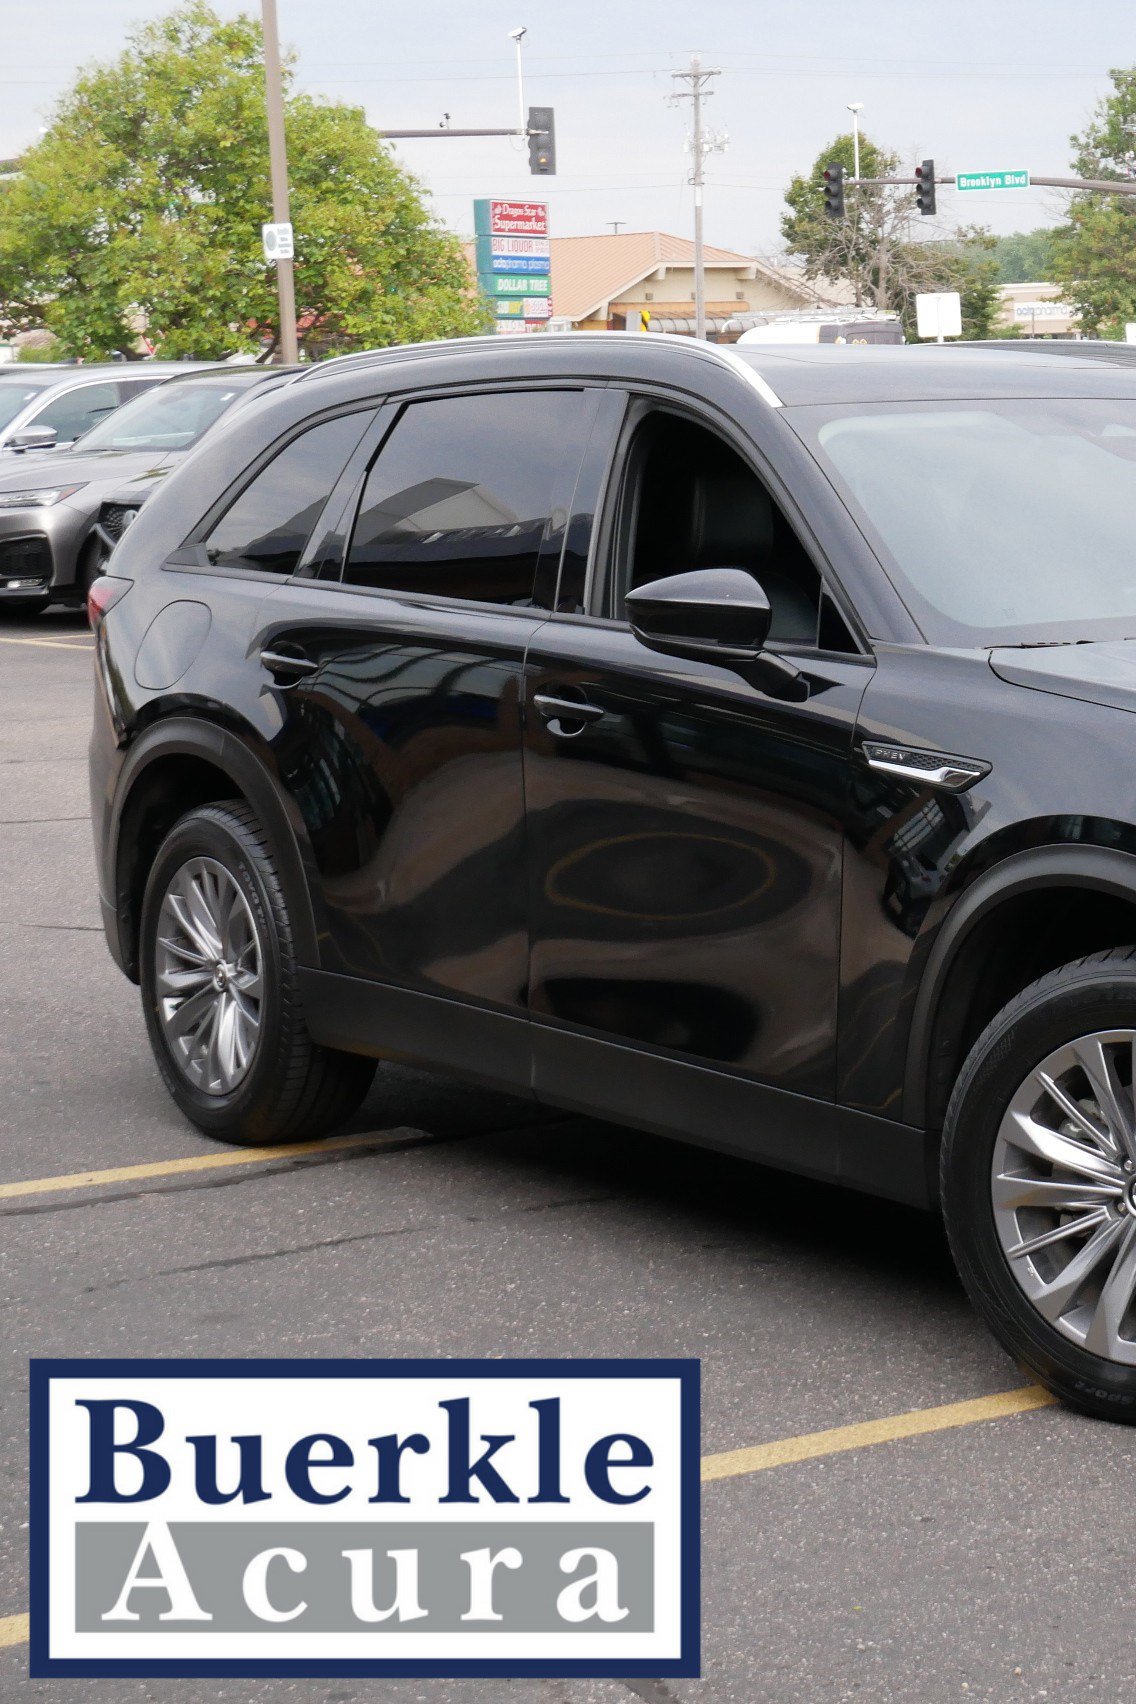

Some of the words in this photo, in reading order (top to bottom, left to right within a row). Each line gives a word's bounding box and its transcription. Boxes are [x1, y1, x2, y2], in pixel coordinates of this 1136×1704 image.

[960, 176, 1001, 188] Brooklyn
[1004, 174, 1026, 185] Blvd
[502, 204, 524, 217] Dragon
[524, 205, 537, 216] Star
[494, 215, 546, 231] Supermarket
[492, 238, 505, 252] BIG
[507, 239, 534, 253] LIQUOR
[498, 278, 527, 291] DOLLAR
[530, 279, 548, 291] TREE
